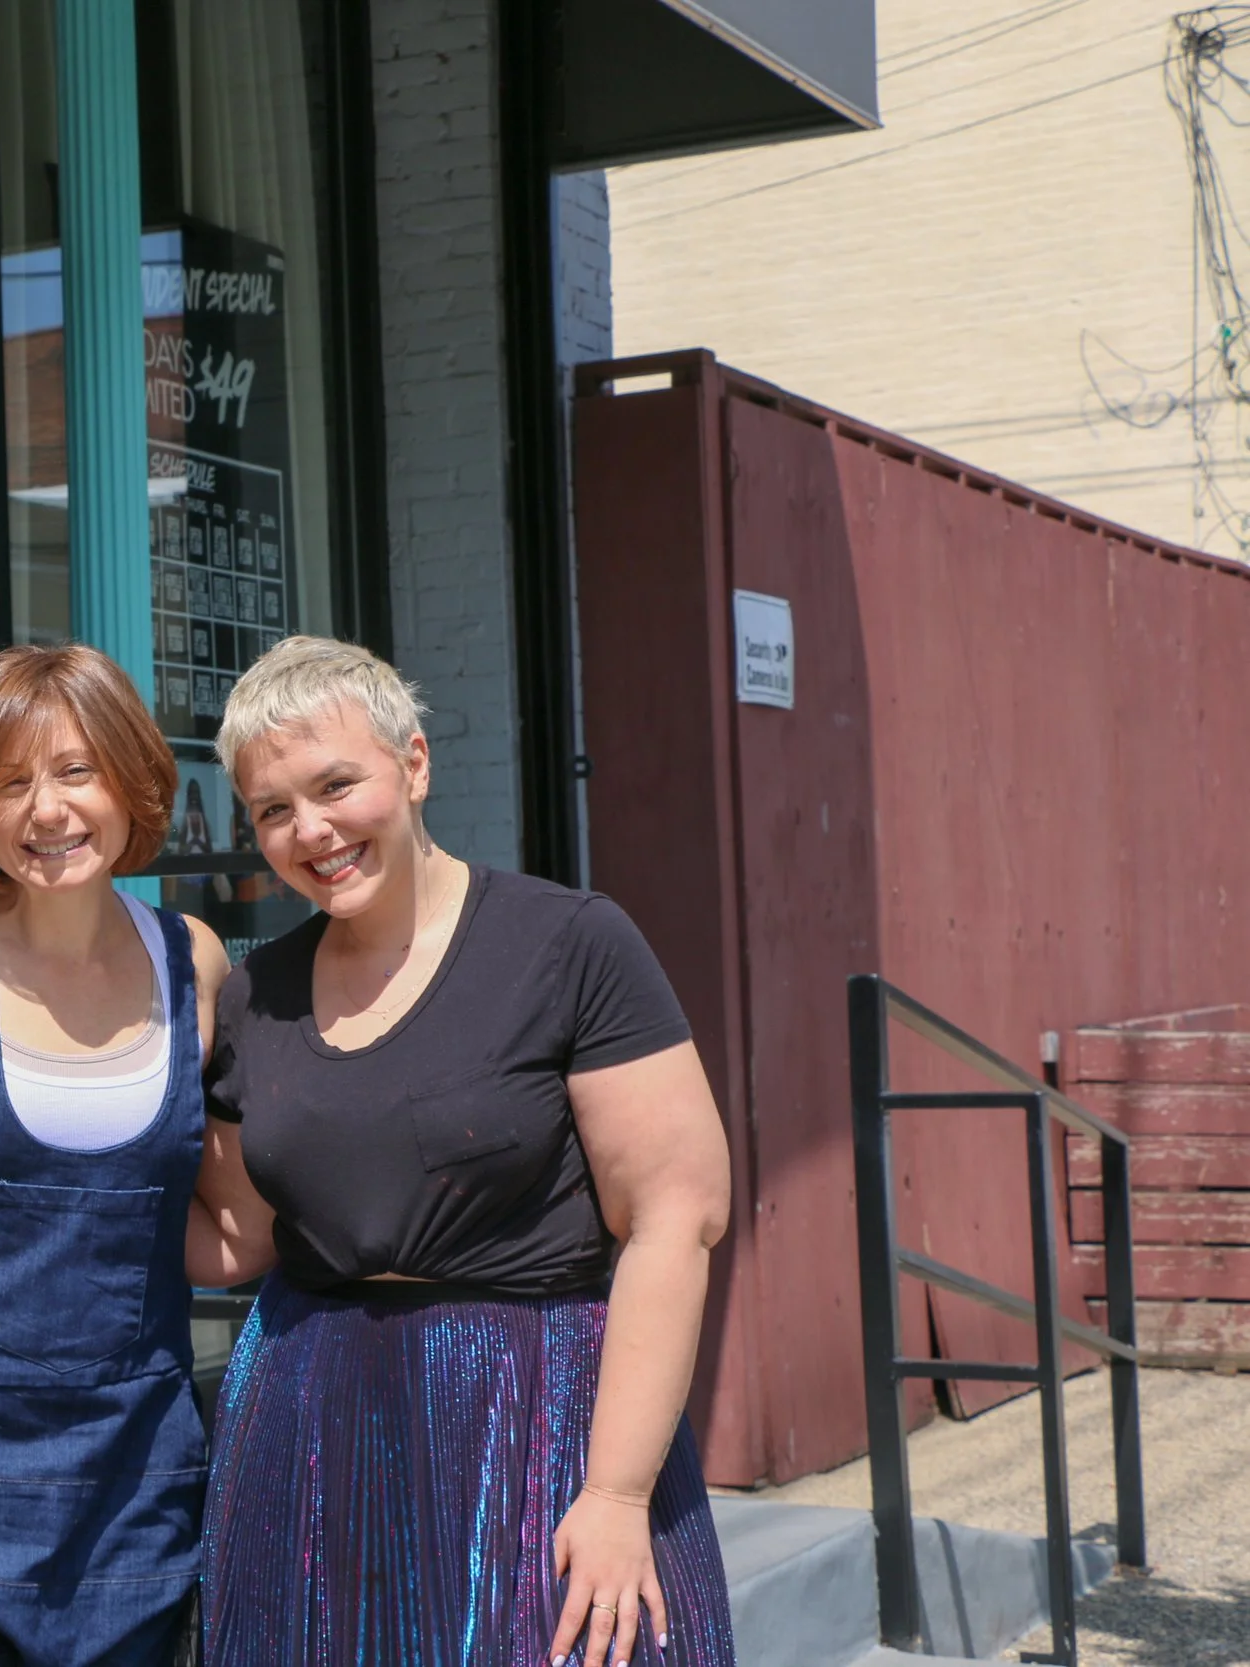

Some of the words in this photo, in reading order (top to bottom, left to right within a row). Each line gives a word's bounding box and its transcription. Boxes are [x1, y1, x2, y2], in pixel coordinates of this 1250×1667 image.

[206, 267, 276, 316] SPECIAL
[193, 343, 255, 429] $49
[150, 452, 216, 490] SCHEDULE
[745, 635, 772, 665] Security
